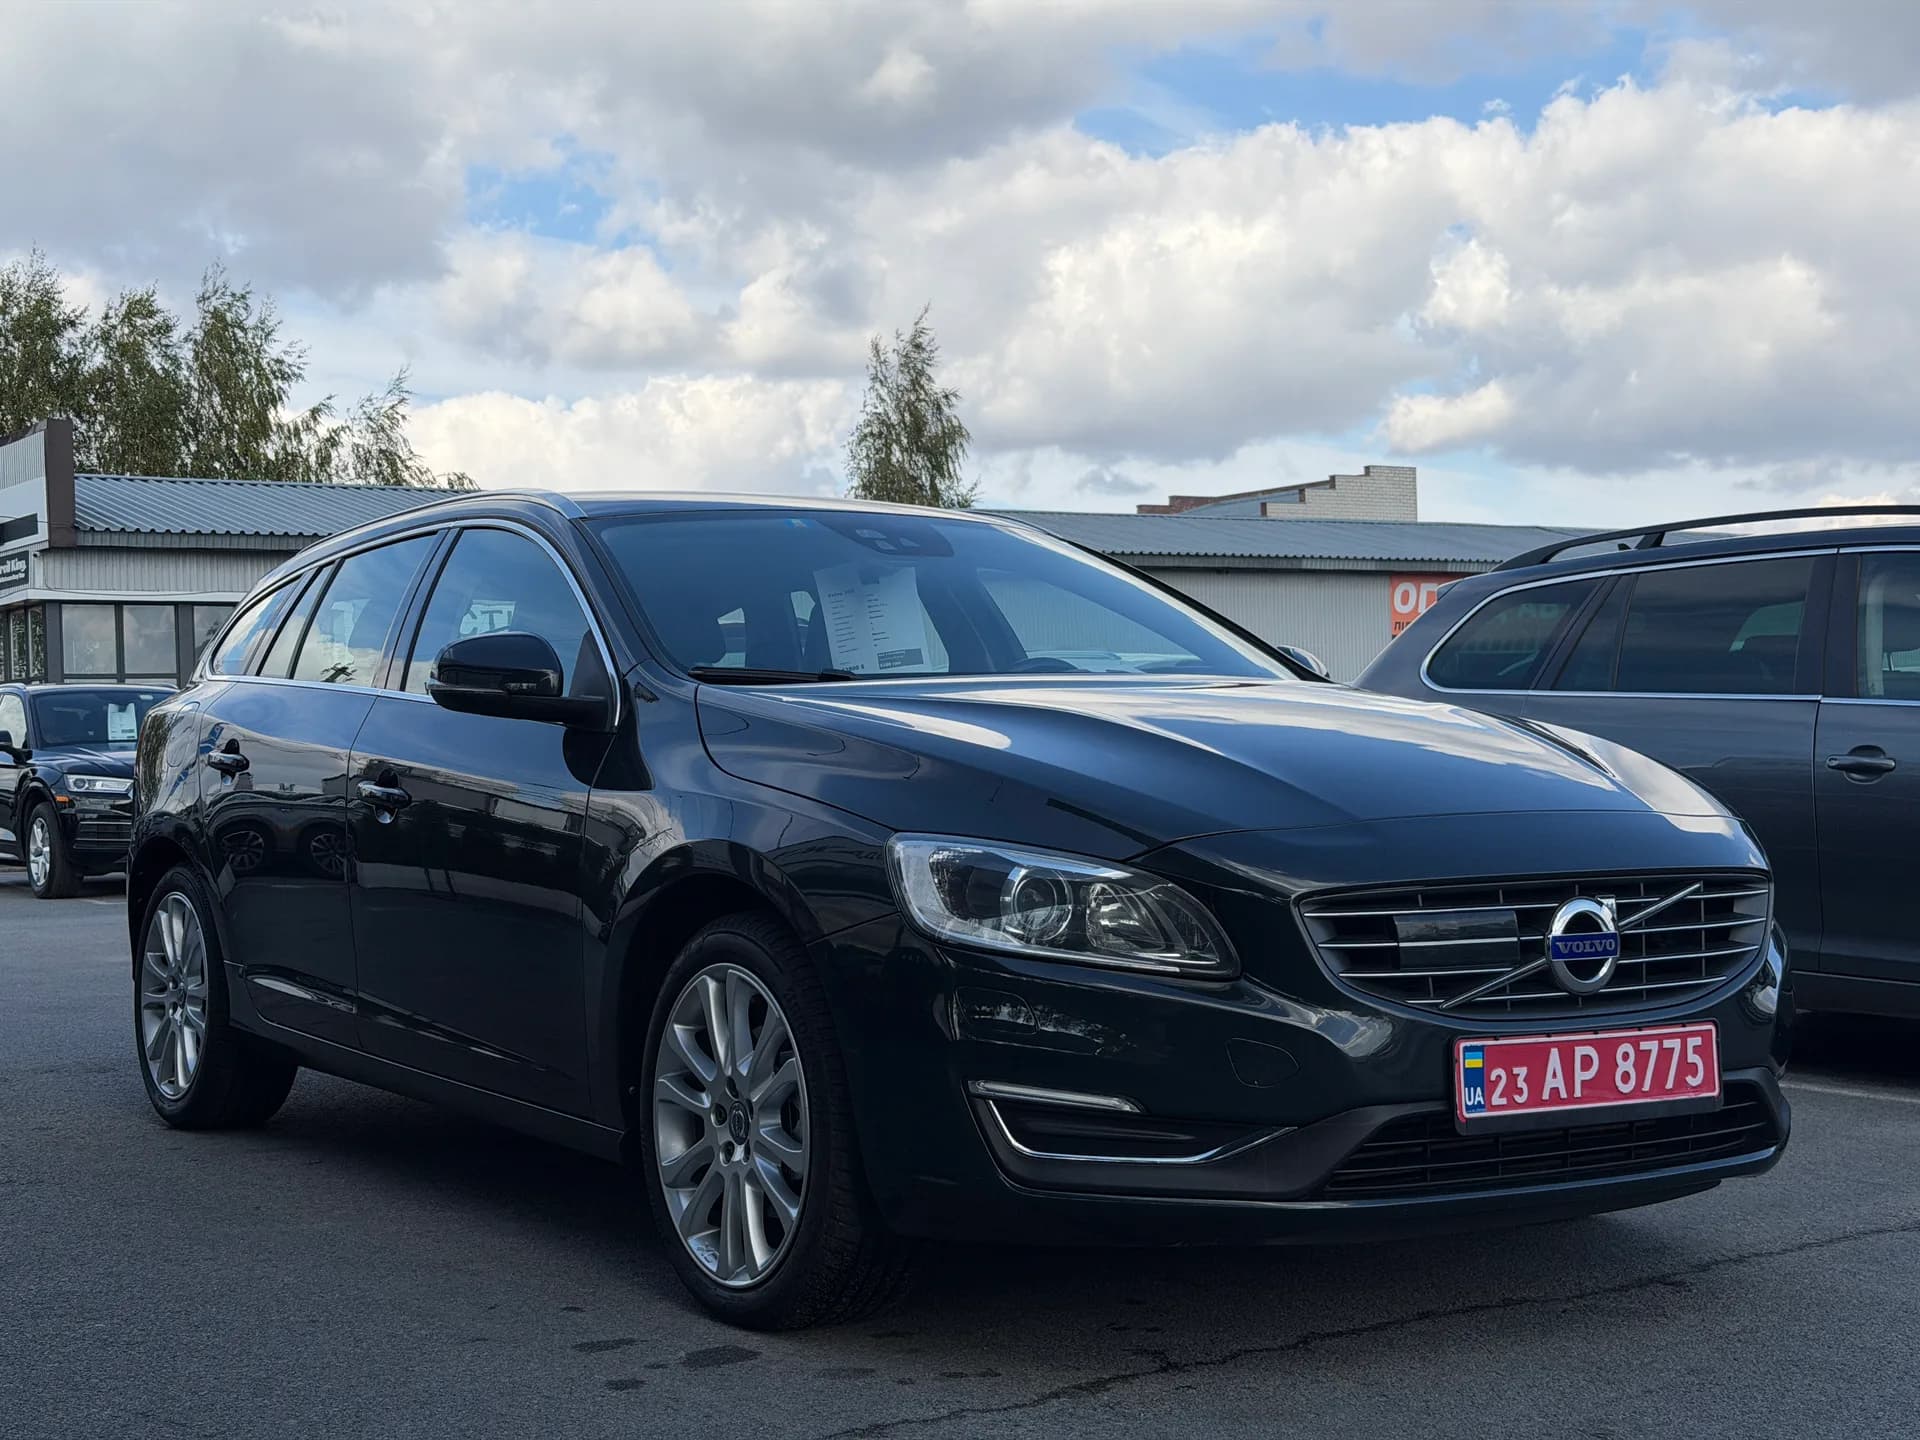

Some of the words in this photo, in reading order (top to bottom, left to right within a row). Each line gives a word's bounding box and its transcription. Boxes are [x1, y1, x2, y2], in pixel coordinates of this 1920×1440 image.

[1555, 939, 1615, 954] VOLVO
[1490, 1067, 1528, 1105] 23
[1541, 1046, 1599, 1100] AP
[1615, 1037, 1704, 1094] 8775
[1465, 1087, 1484, 1105] UA
